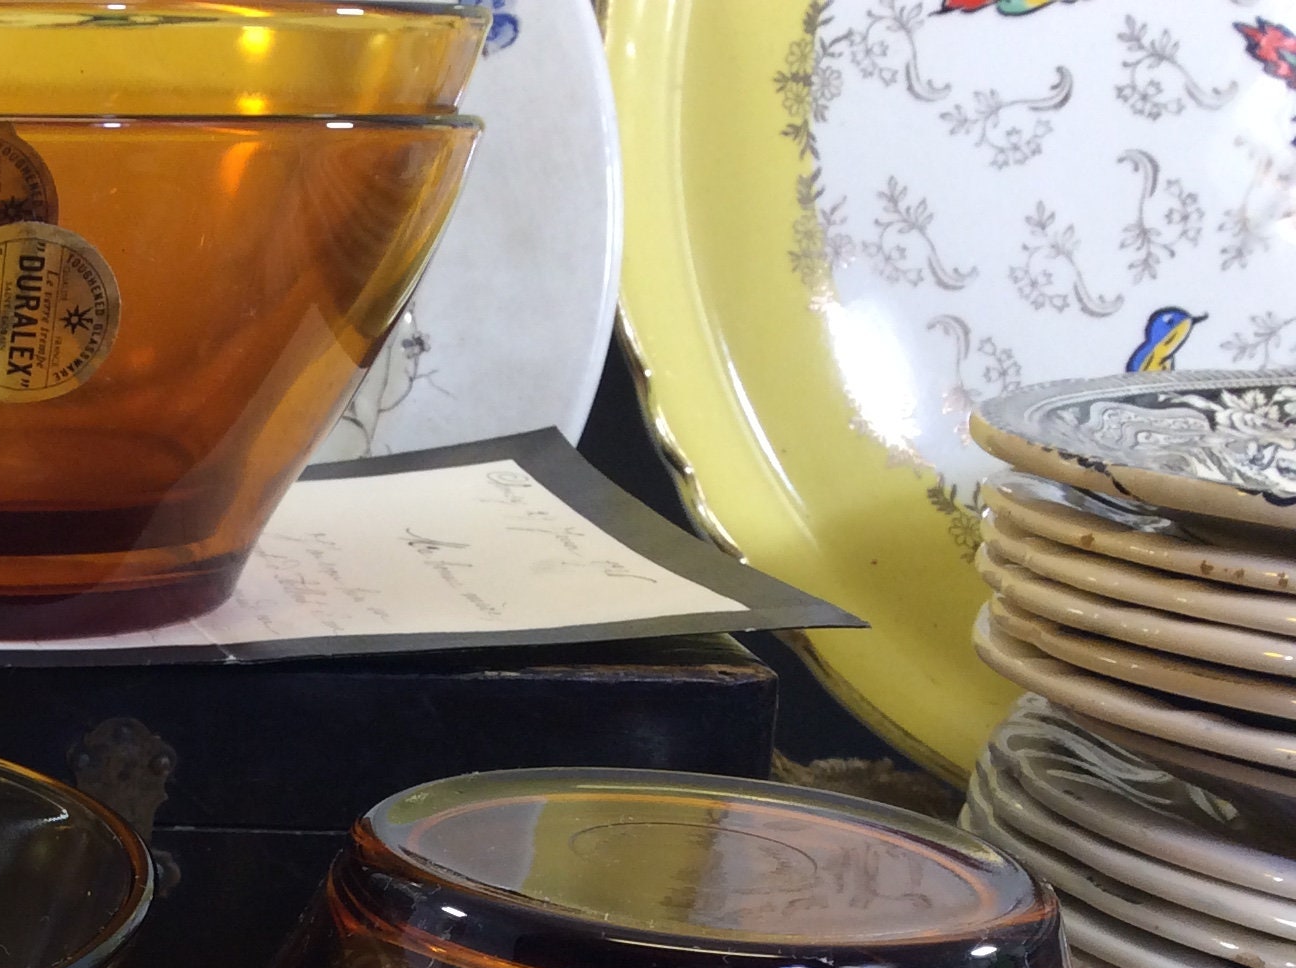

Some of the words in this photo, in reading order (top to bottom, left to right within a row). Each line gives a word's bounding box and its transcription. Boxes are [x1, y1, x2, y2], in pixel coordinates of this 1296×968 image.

[46, 270, 60, 288] Le
[66, 254, 104, 316] TOUGHENED
[52, 323, 104, 382] GLASSWARE
